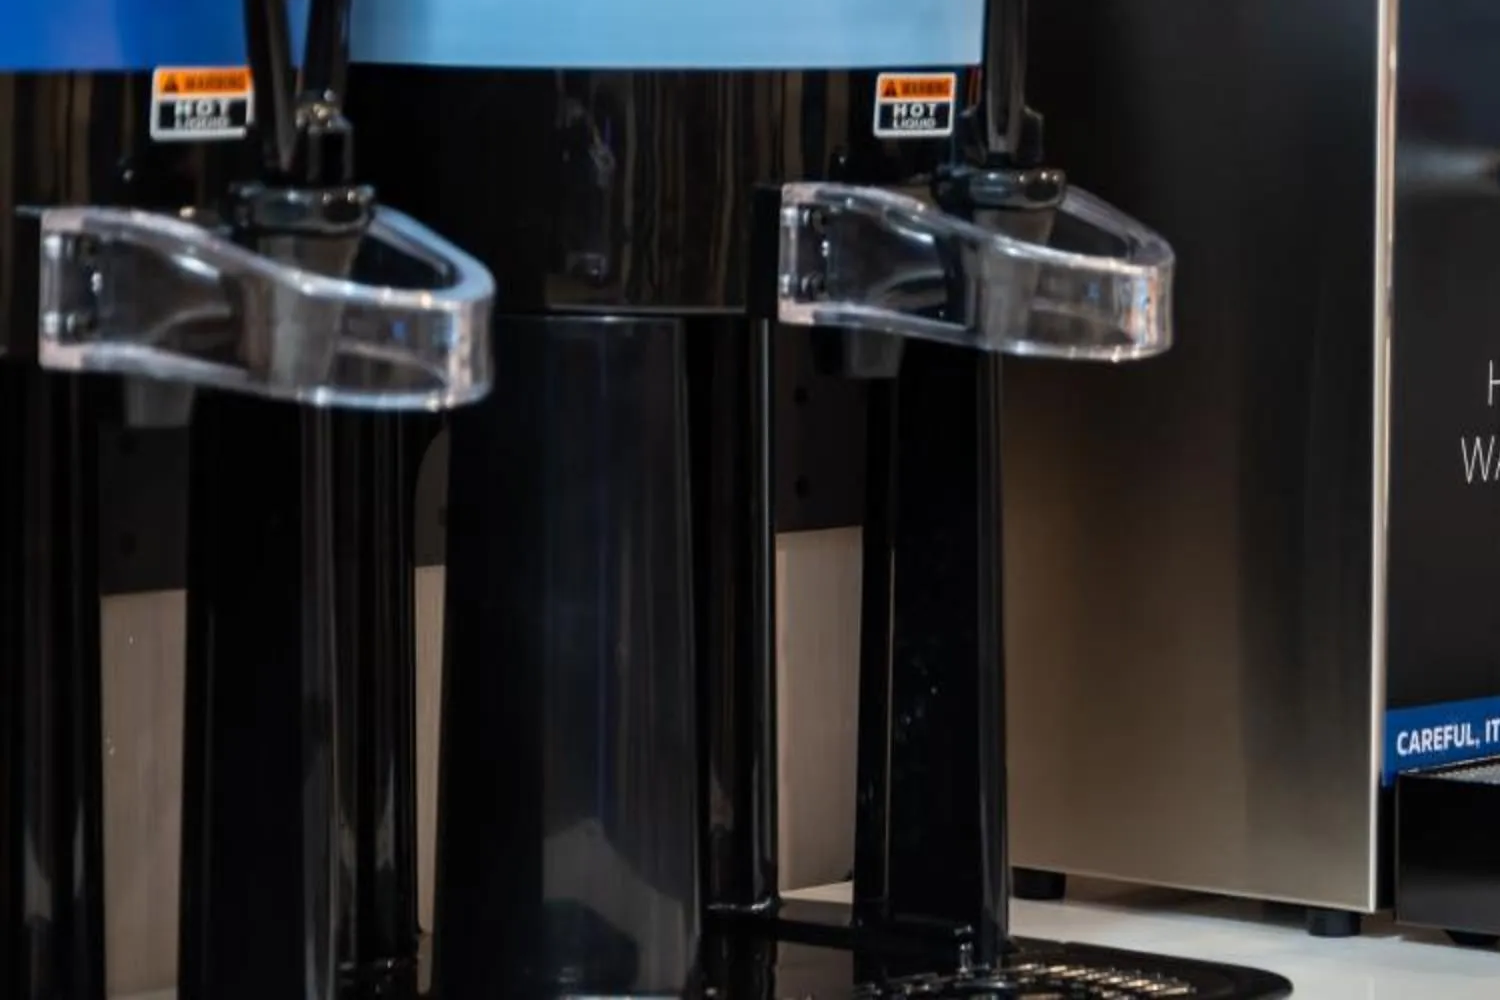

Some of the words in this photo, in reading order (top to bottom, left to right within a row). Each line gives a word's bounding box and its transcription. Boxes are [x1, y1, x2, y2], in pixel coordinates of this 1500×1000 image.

[175, 99, 229, 116] HOT
[893, 103, 937, 118] HOT
[893, 117, 937, 130] LIQUID
[1396, 722, 1481, 757] CAREFUL,
